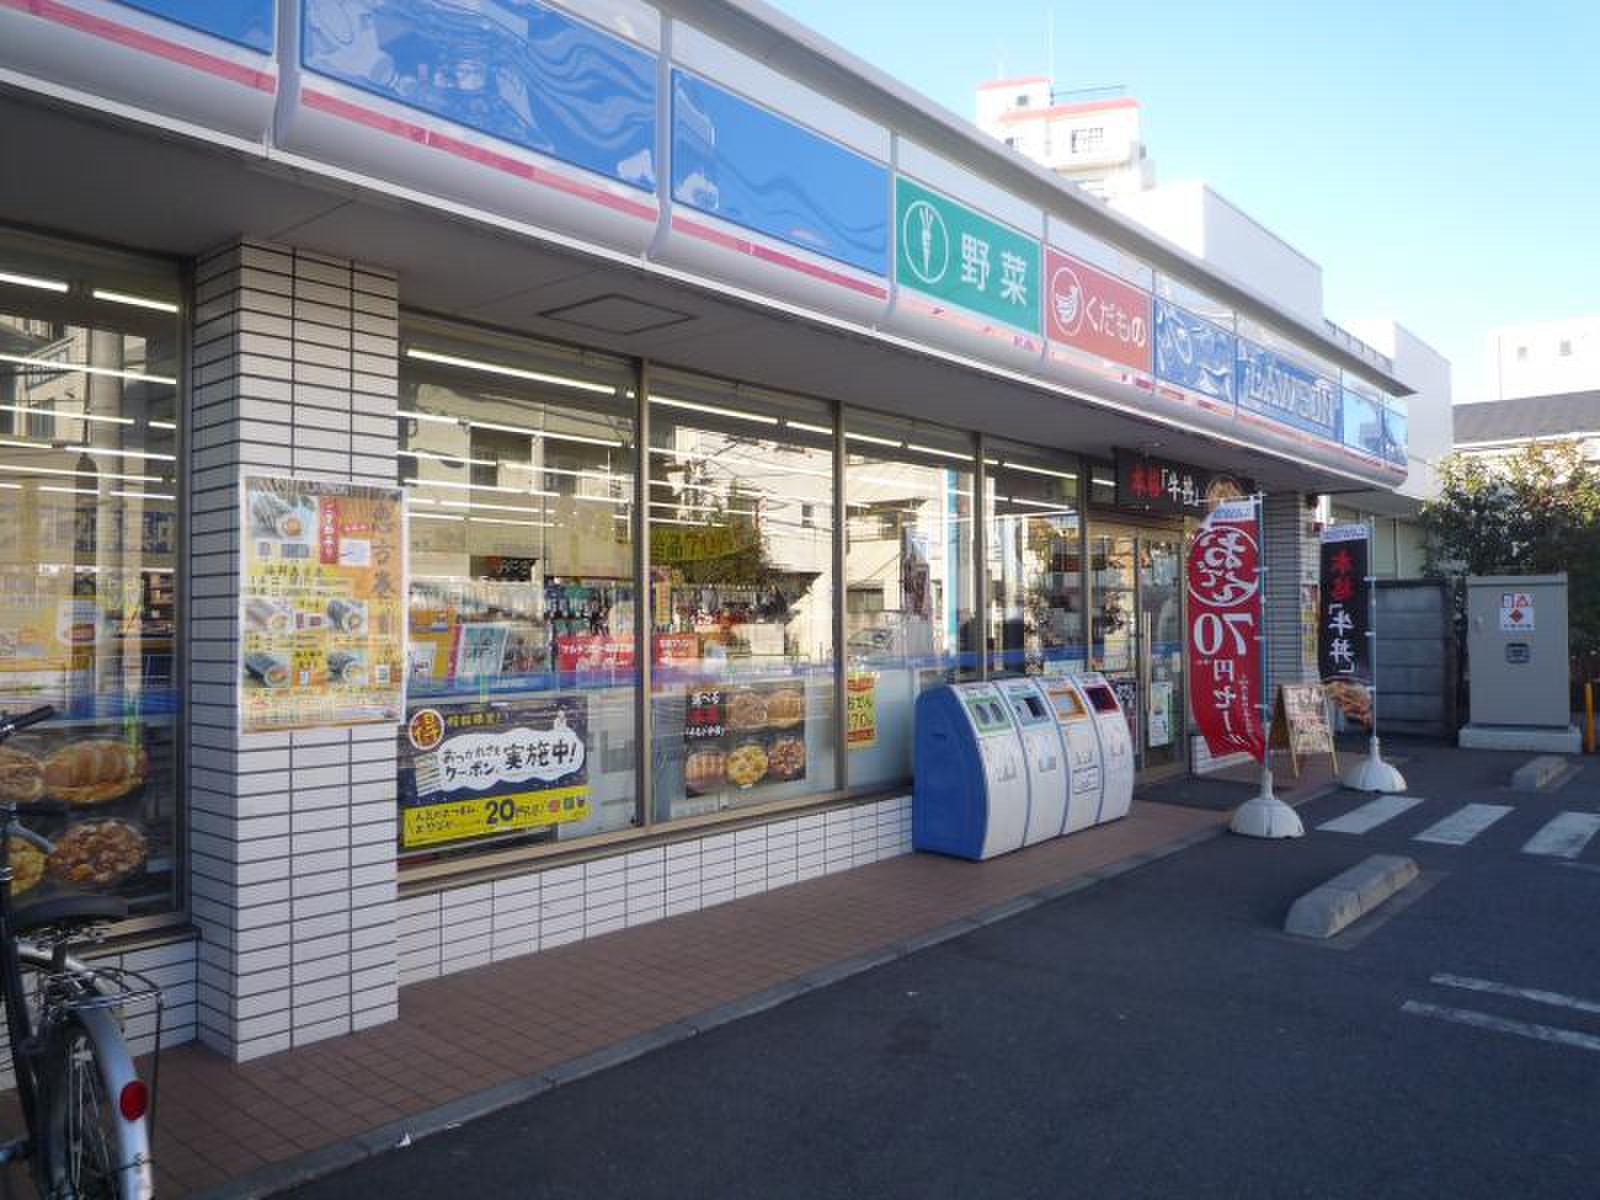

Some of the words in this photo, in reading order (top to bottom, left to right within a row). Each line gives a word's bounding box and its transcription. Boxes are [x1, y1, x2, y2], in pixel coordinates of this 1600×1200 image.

[960, 232, 1028, 307] 野菜
[1085, 295, 1147, 349] くだもの
